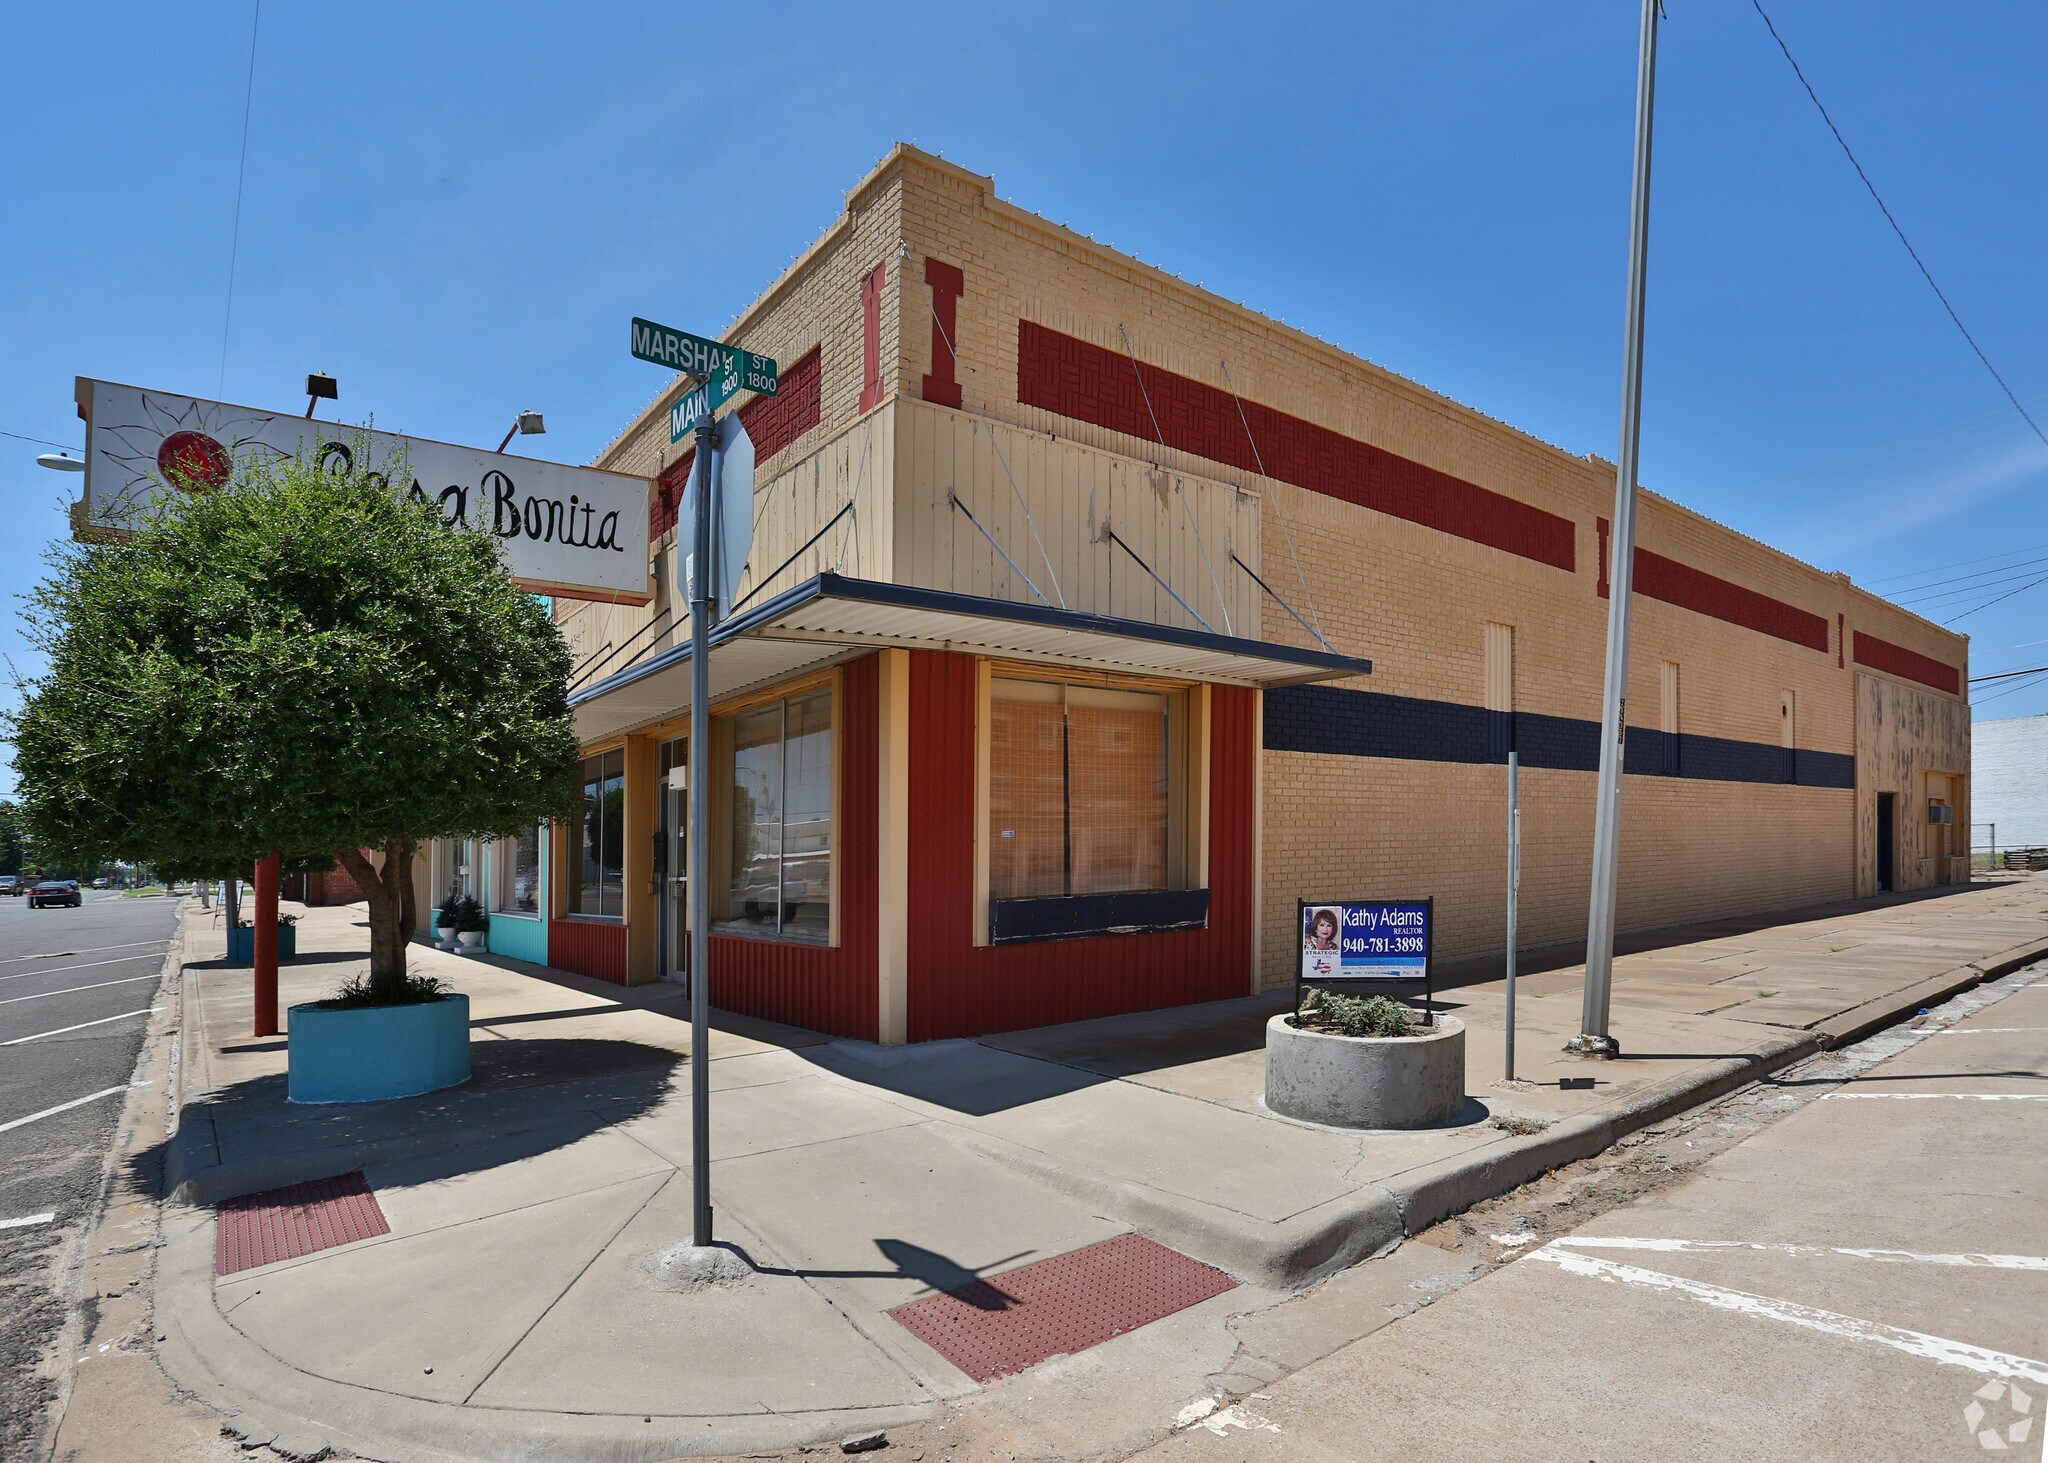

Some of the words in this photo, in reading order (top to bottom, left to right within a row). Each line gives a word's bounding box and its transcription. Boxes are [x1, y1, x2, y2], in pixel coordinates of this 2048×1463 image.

[752, 354, 768, 371] ST
[721, 371, 738, 397] 1900
[747, 372, 776, 392] 1800
[672, 384, 711, 437] MAIN
[724, 355, 734, 375] ST
[481, 469, 624, 552] Bonita
[1342, 908, 1378, 931] Kathy
[1380, 907, 1424, 926] Adams
[1393, 927, 1423, 935] REALTOR
[1343, 937, 1424, 953] 940-781-3898
